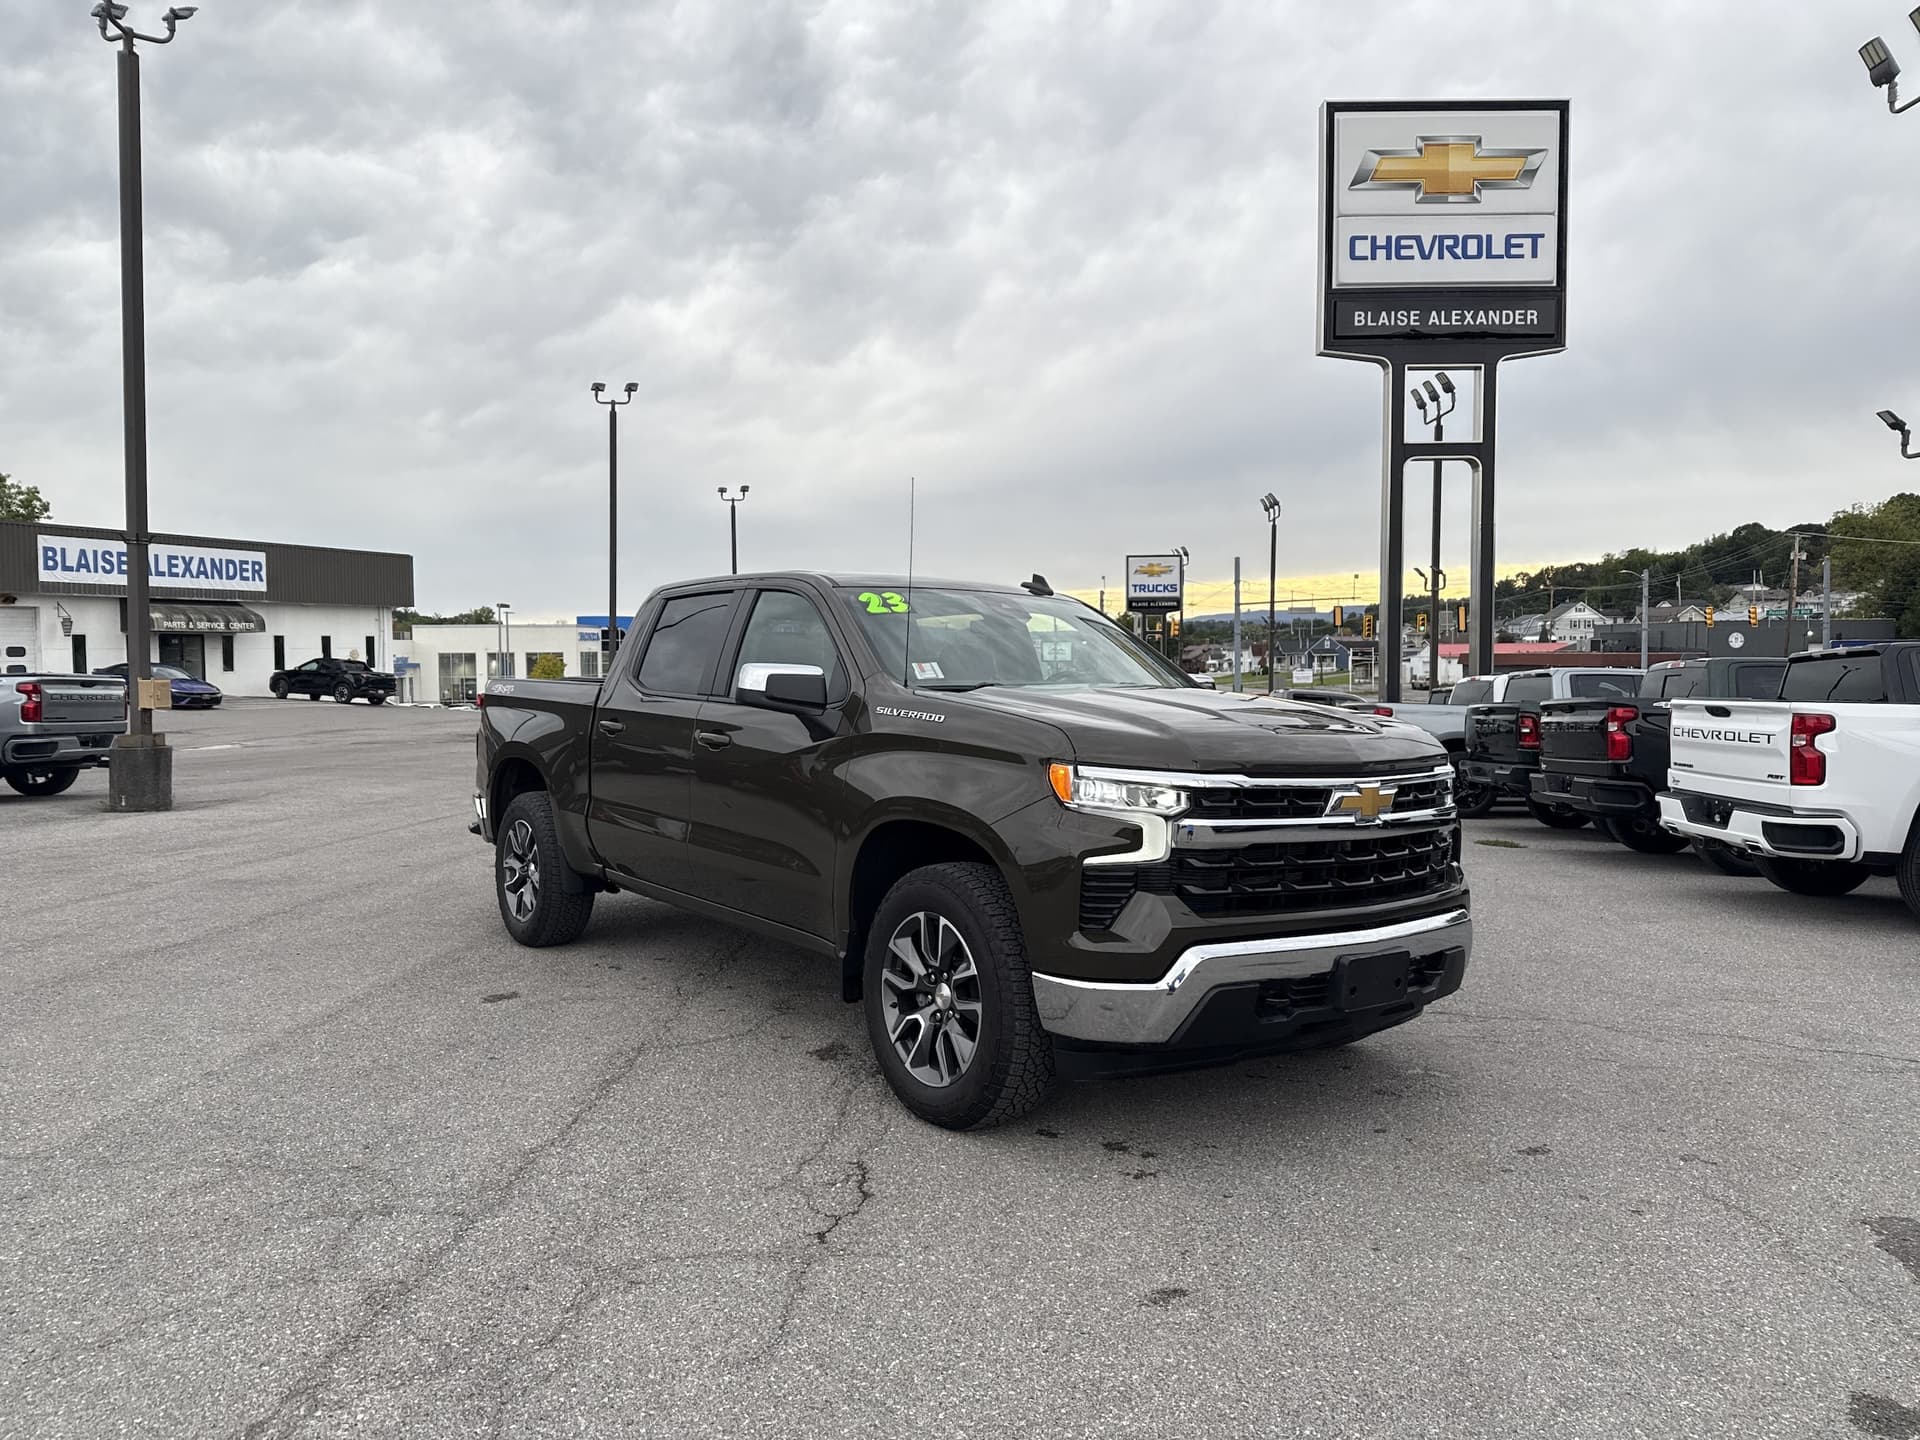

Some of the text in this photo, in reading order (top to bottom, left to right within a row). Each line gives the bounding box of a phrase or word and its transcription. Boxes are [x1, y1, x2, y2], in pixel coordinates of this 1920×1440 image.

[1349, 233, 1545, 261] CHEVROLET
[1354, 309, 1538, 327] BLAISE ALEXANDER
[42, 546, 264, 582] BLAISE LEXANDER
[1131, 583, 1178, 593] TRUCKS
[858, 592, 911, 613] 23
[163, 621, 255, 630] PARTS & SERVICE CENTER
[875, 706, 945, 723] SILVERADO
[1673, 727, 1776, 744] CHEVROLET
